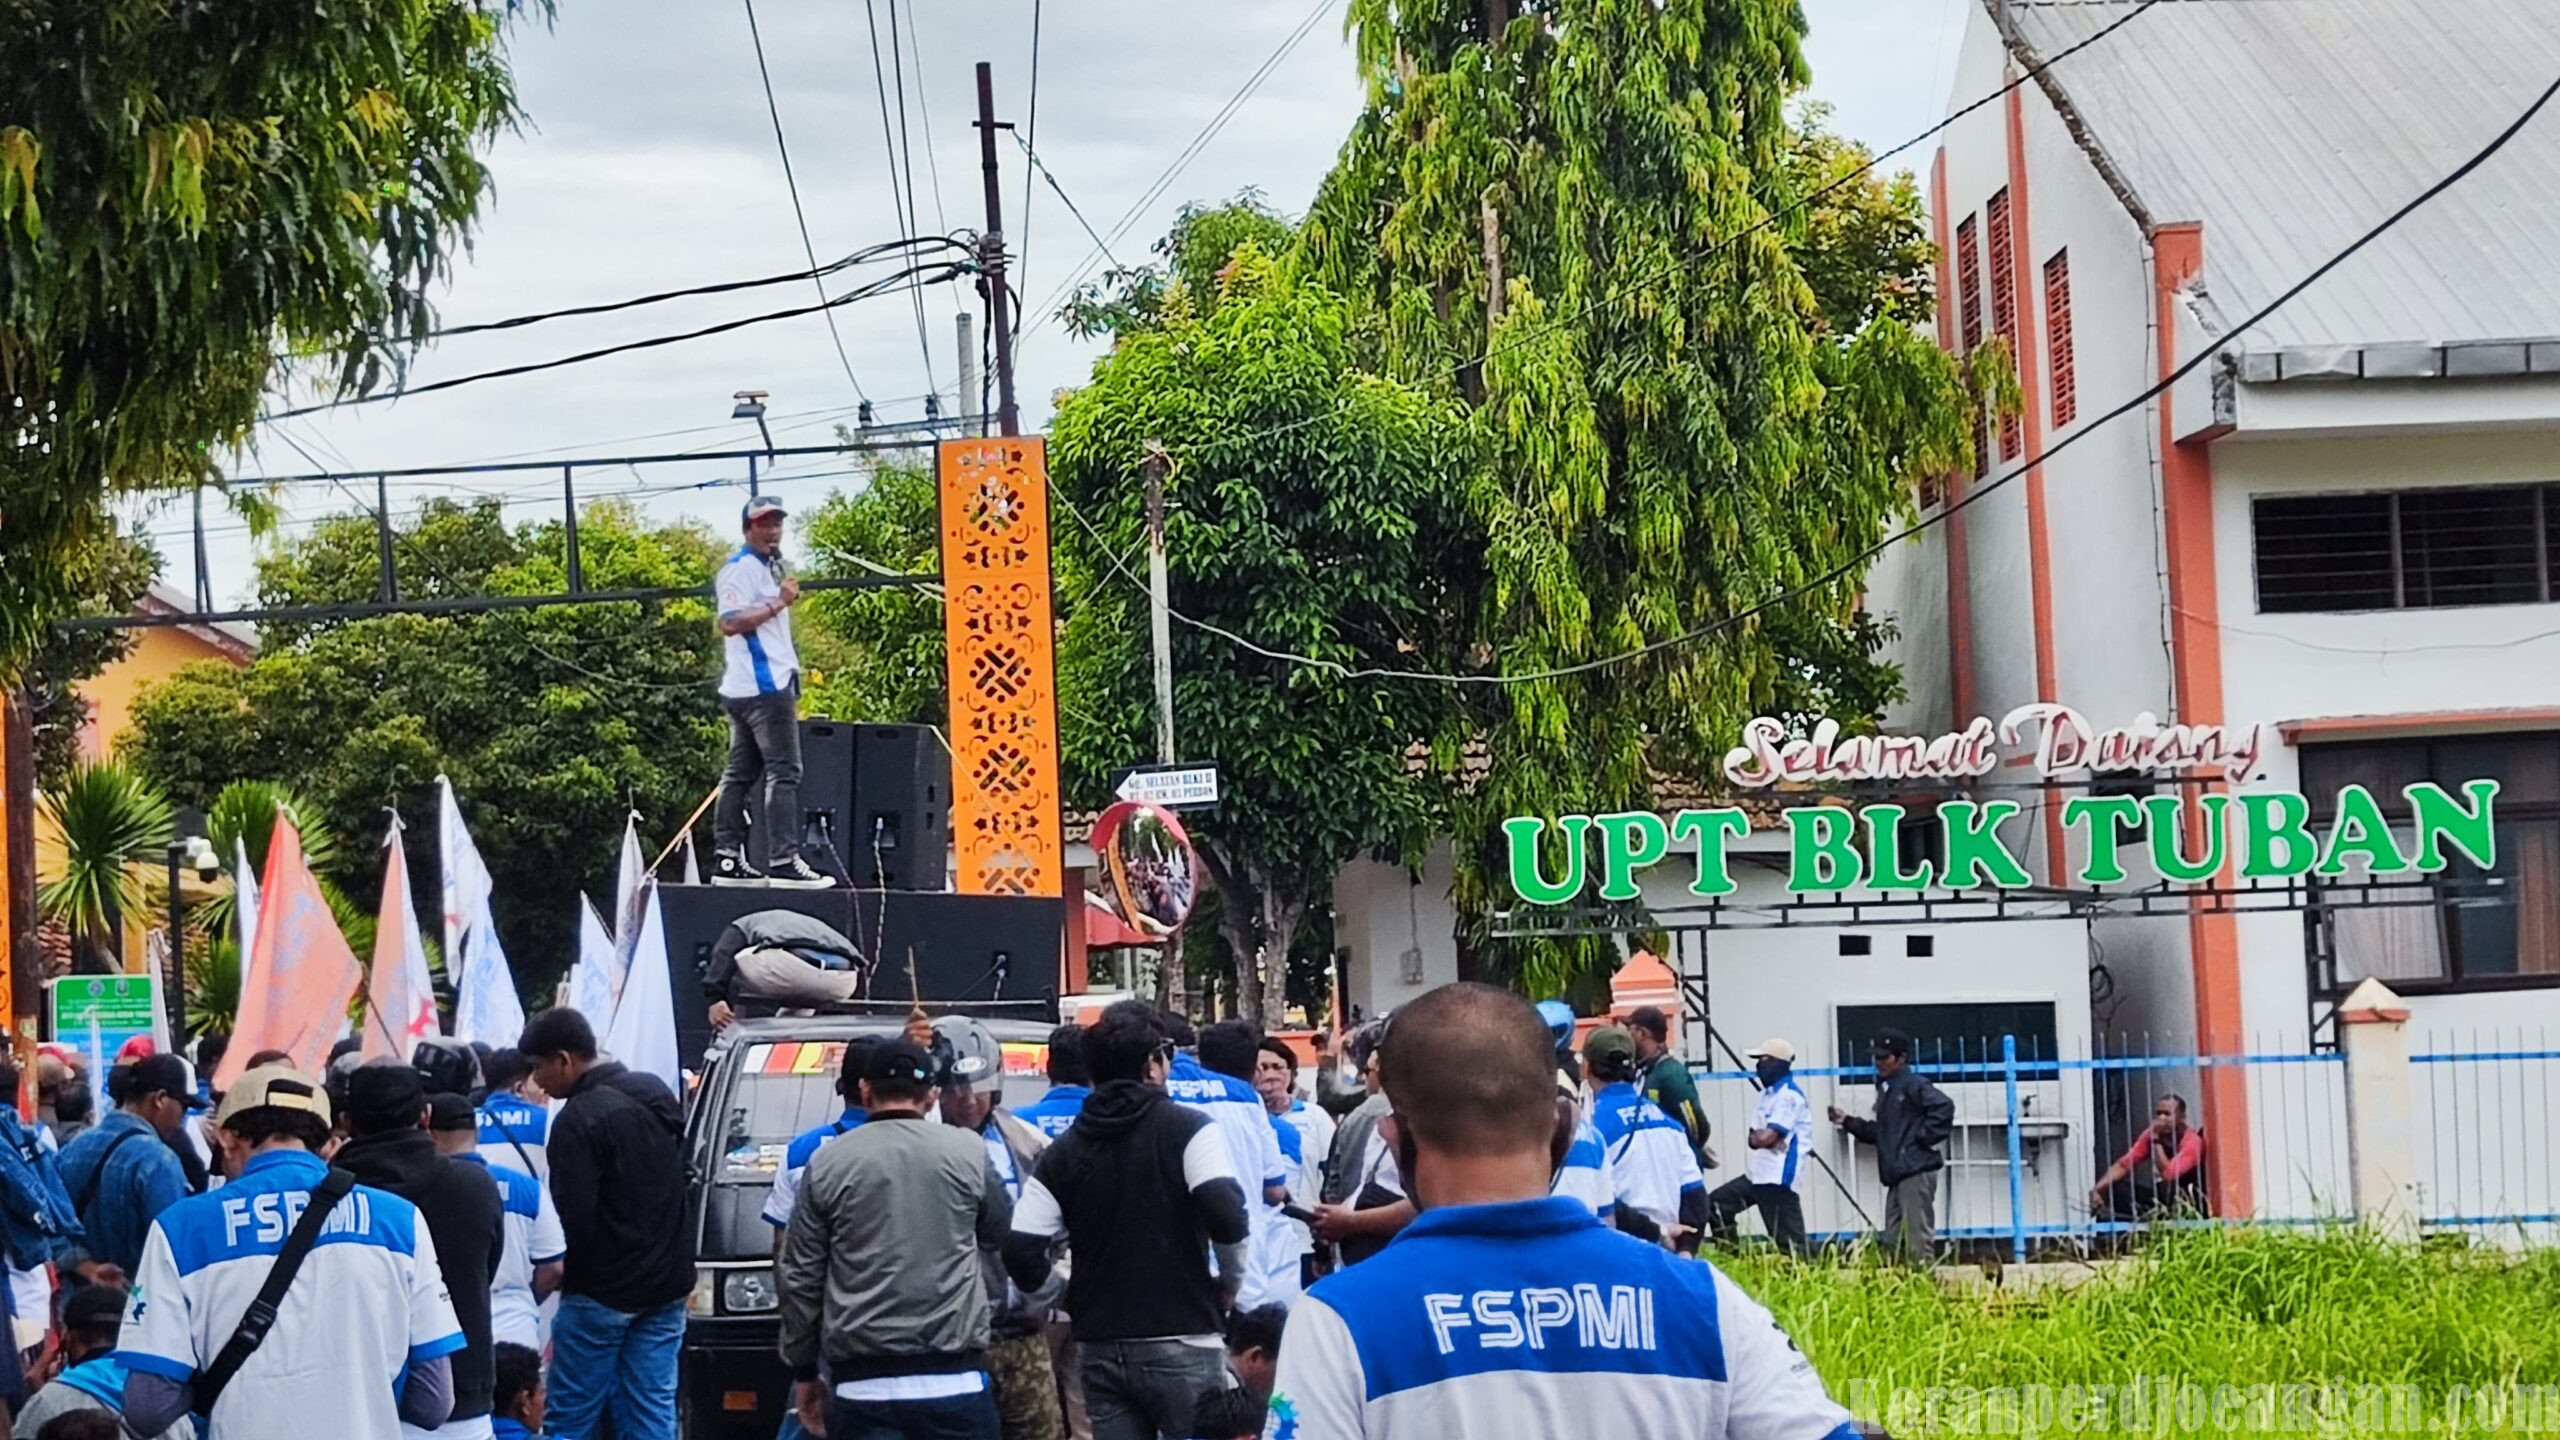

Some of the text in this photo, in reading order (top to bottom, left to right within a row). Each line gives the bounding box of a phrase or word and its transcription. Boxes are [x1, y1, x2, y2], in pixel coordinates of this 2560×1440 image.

[1723, 703, 2264, 786] Selamat Datang
[1502, 779, 2499, 905] UPT BLK TUBAN
[1165, 1079, 1228, 1098] FSPMI
[1423, 1283, 1657, 1355] FSPMI
